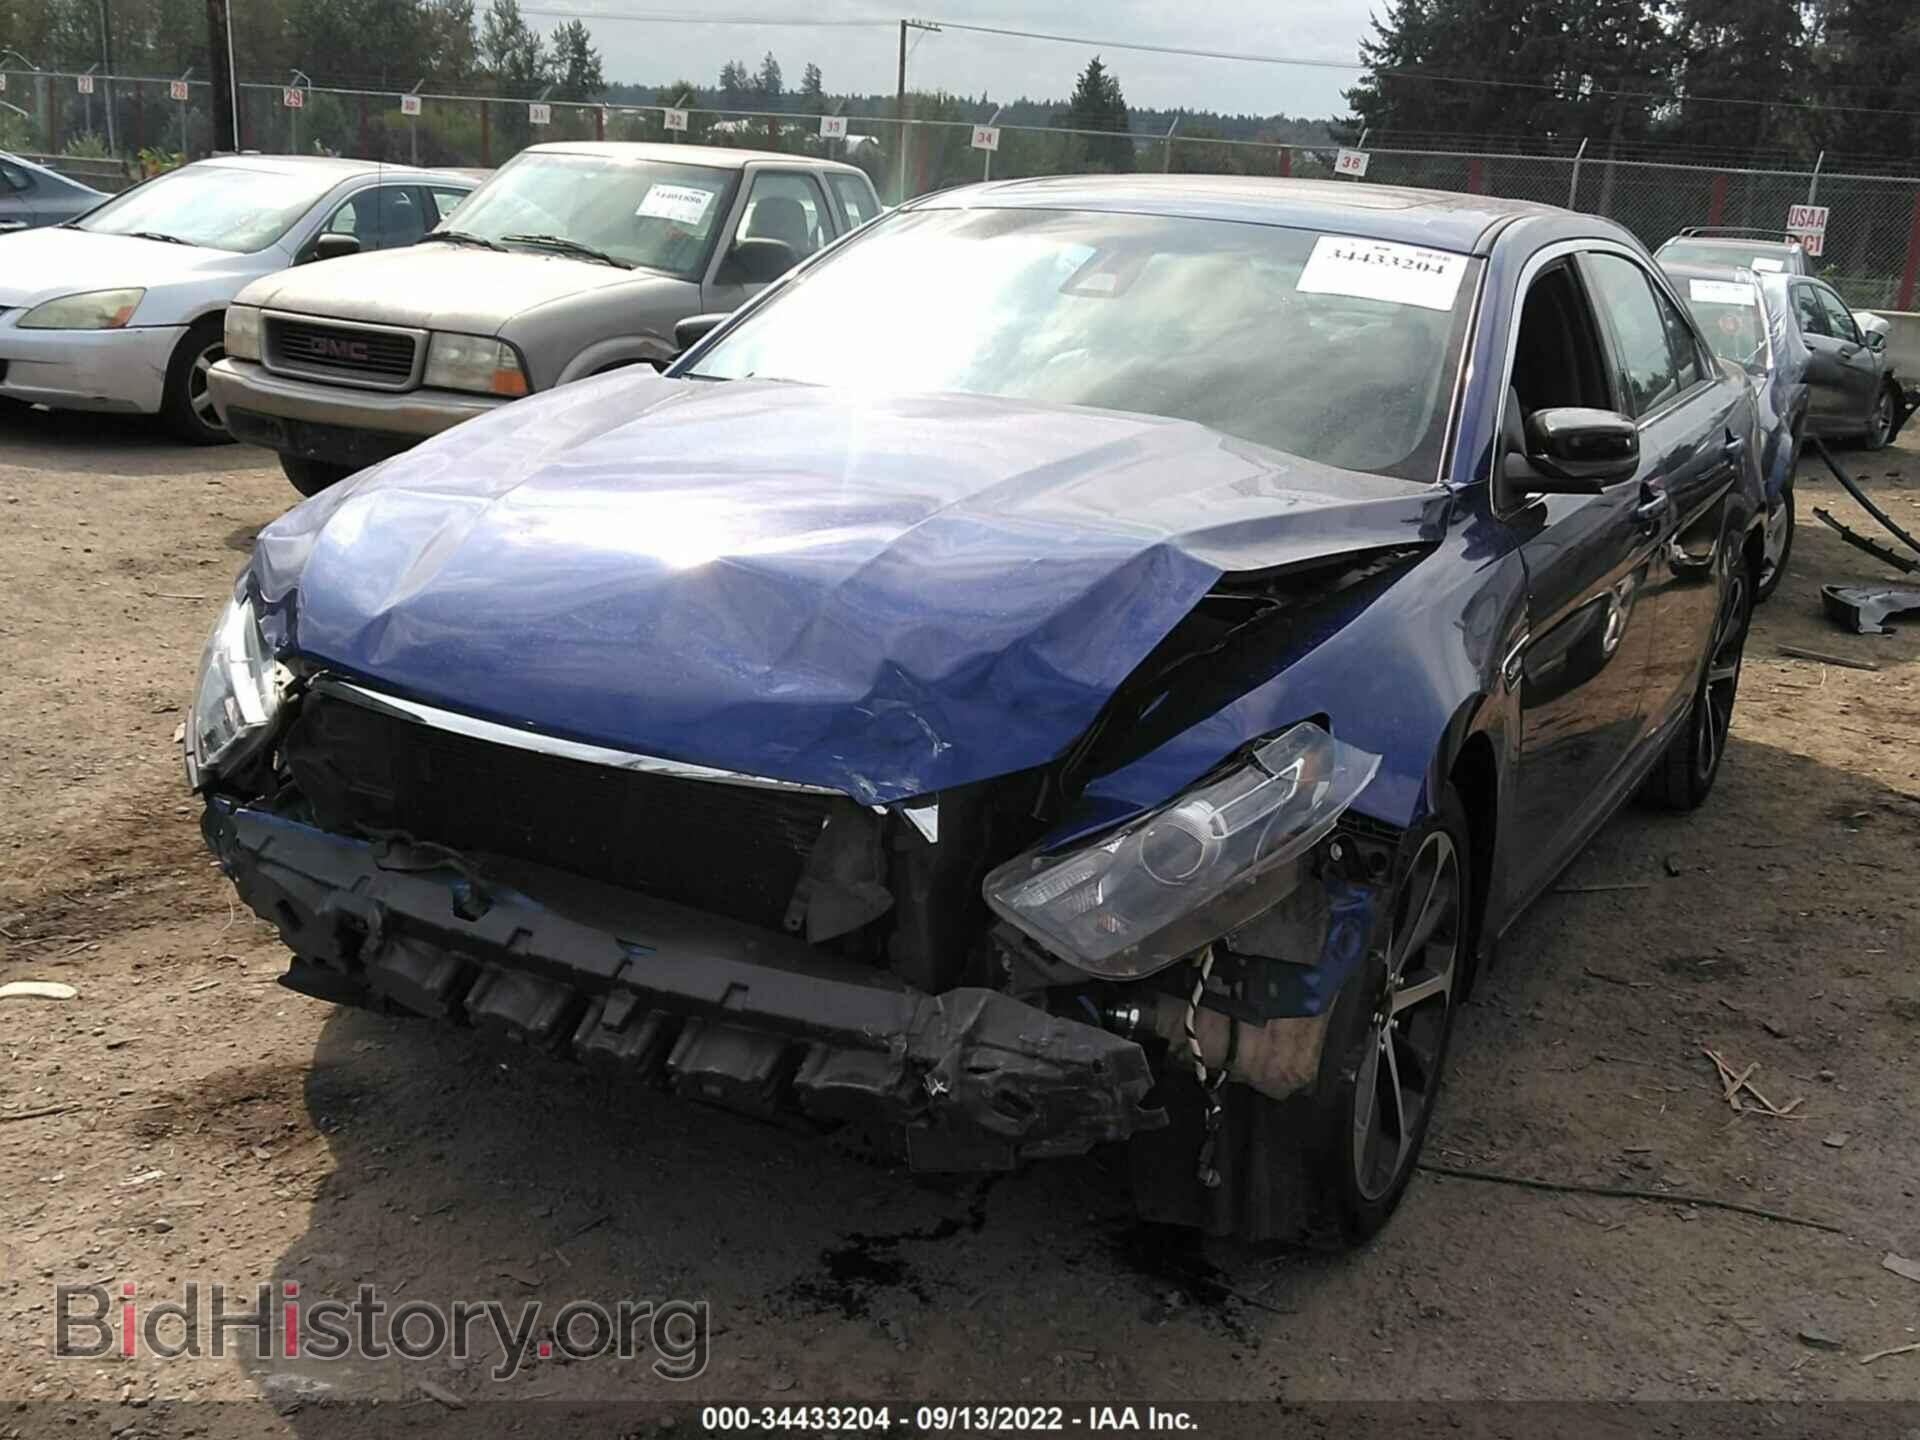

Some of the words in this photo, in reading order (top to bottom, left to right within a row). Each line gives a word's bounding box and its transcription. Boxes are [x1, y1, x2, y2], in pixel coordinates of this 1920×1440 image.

[287, 89, 302, 106] 29
[977, 132, 992, 144] 34
[1790, 207, 1825, 228] USAA
[1327, 249, 1445, 275] 34433204
